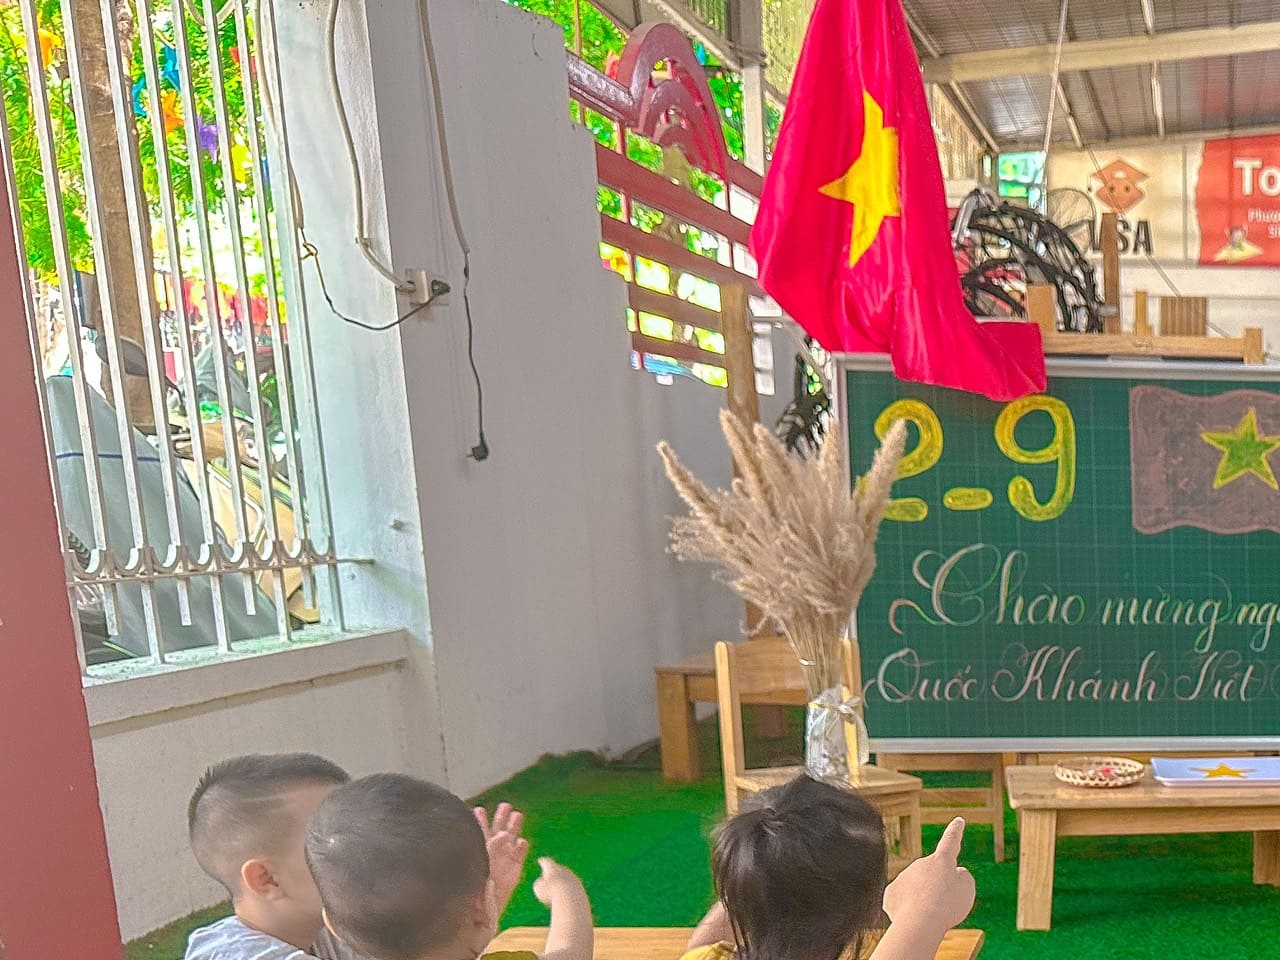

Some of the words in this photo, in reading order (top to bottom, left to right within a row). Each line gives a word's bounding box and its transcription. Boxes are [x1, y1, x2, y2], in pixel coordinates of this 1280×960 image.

[858, 394, 1076, 522] 2-9
[889, 543, 1086, 634] Chào
[1101, 573, 1232, 653] mừng
[863, 648, 982, 708] Quốc
[991, 643, 1168, 701] Khánh
